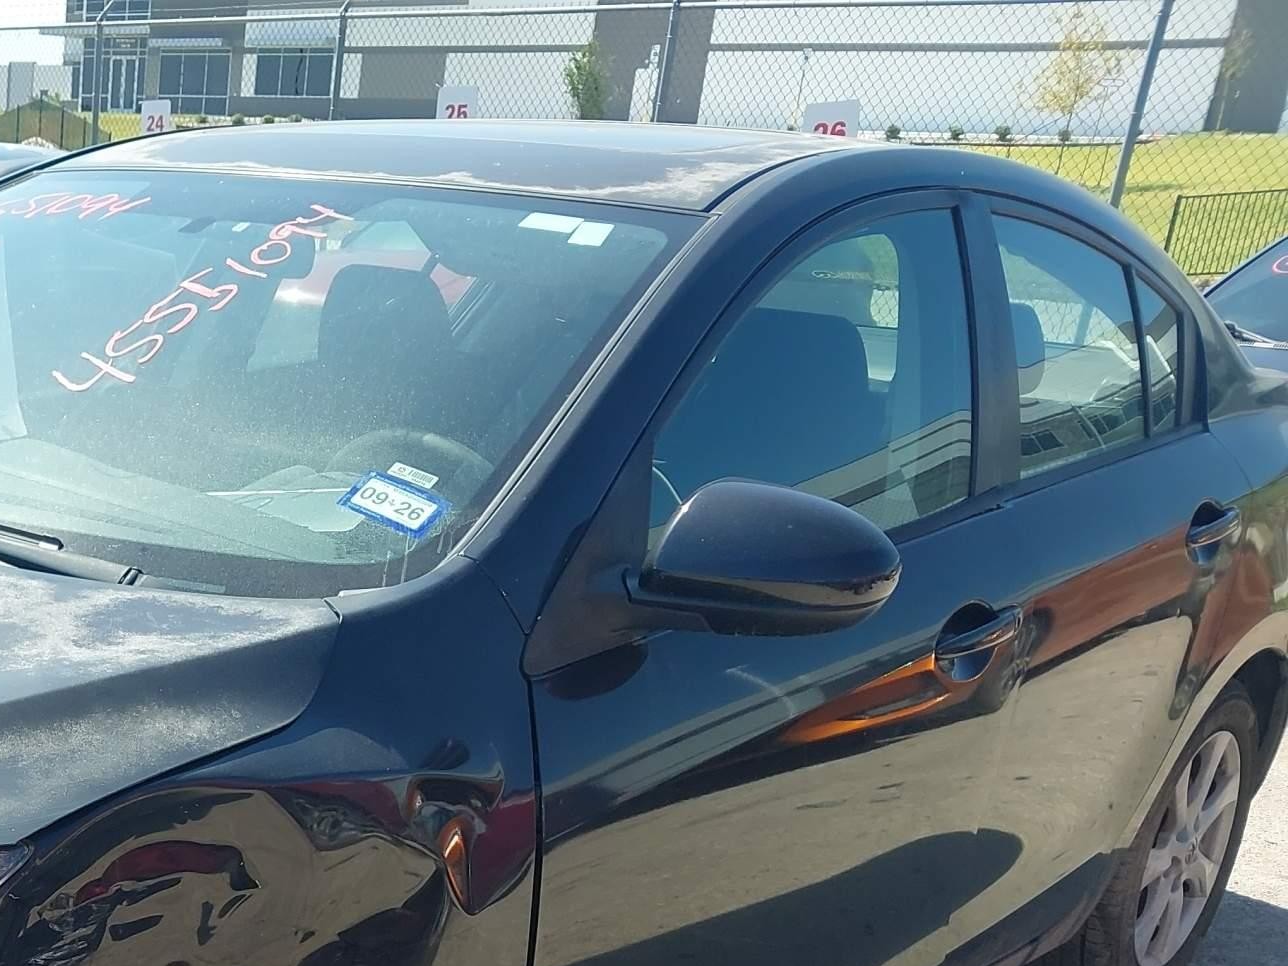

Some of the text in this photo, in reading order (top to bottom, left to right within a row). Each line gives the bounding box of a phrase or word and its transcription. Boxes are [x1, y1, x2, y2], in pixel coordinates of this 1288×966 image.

[146, 114, 165, 132] 24
[52, 204, 354, 392] 45551094
[359, 486, 389, 505] 09
[393, 501, 425, 521] 26
